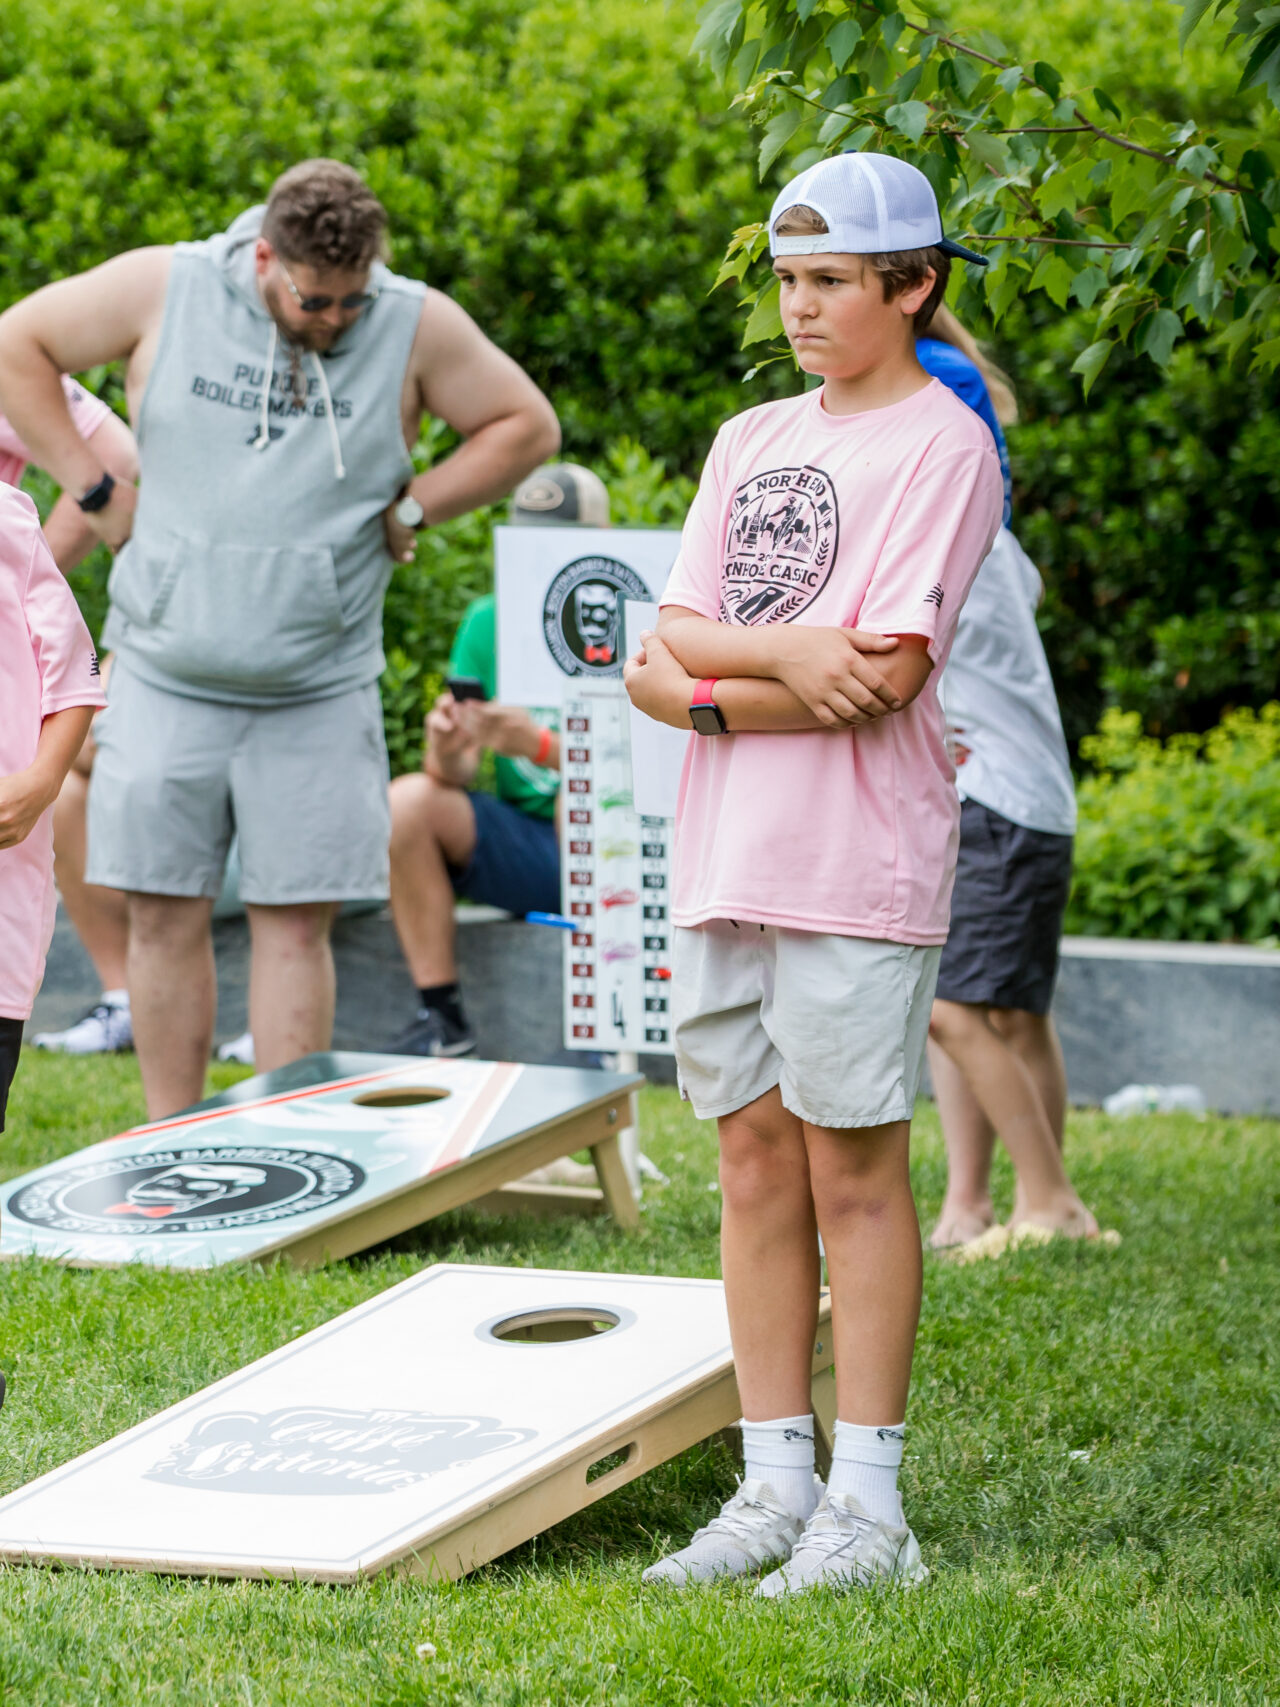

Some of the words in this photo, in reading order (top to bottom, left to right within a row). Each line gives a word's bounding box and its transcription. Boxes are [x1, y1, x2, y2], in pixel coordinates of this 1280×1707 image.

[234, 363, 320, 396] PURDE
[757, 473, 811, 492] NORH
[612, 991, 626, 1038] 4
